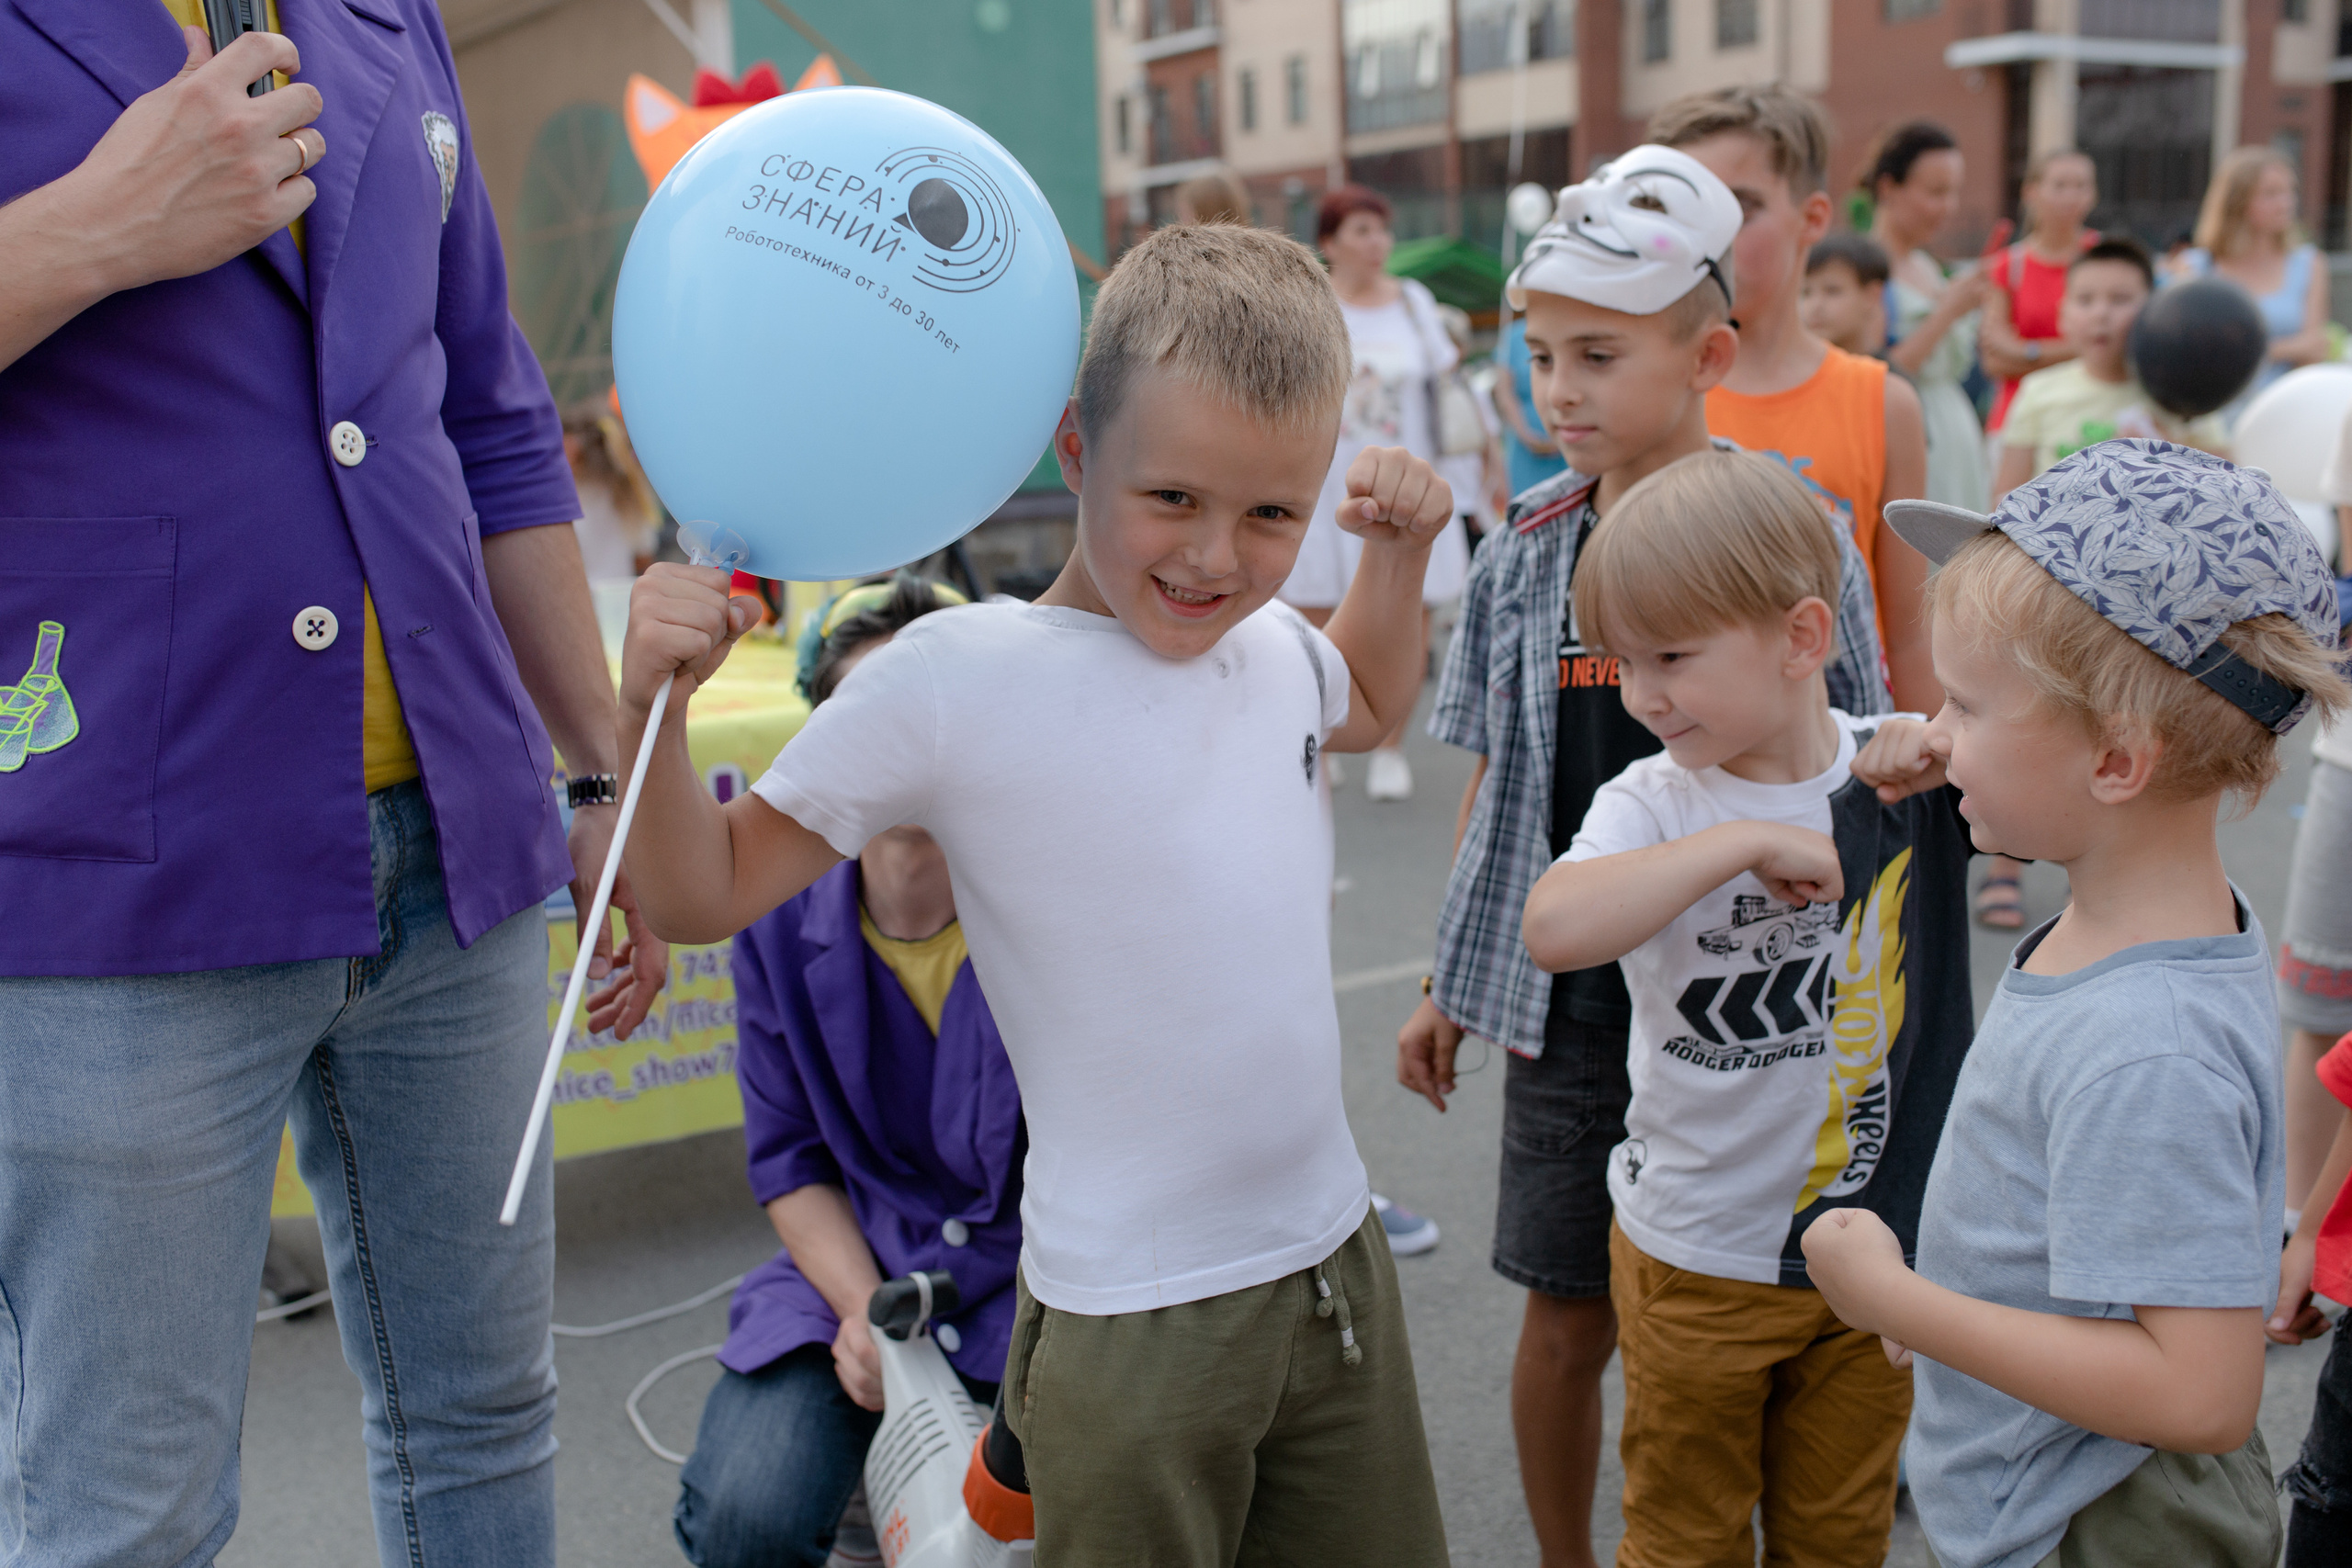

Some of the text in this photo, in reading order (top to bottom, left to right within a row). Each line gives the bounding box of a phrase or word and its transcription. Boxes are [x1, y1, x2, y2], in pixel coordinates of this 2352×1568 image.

[761, 153, 883, 213] СФЕРА
[742, 184, 902, 263] ЗНАНИЙ
[725, 226, 961, 355] Робототехника от 3 до 30 лет
[1661, 1040, 1746, 1072] RODGER
